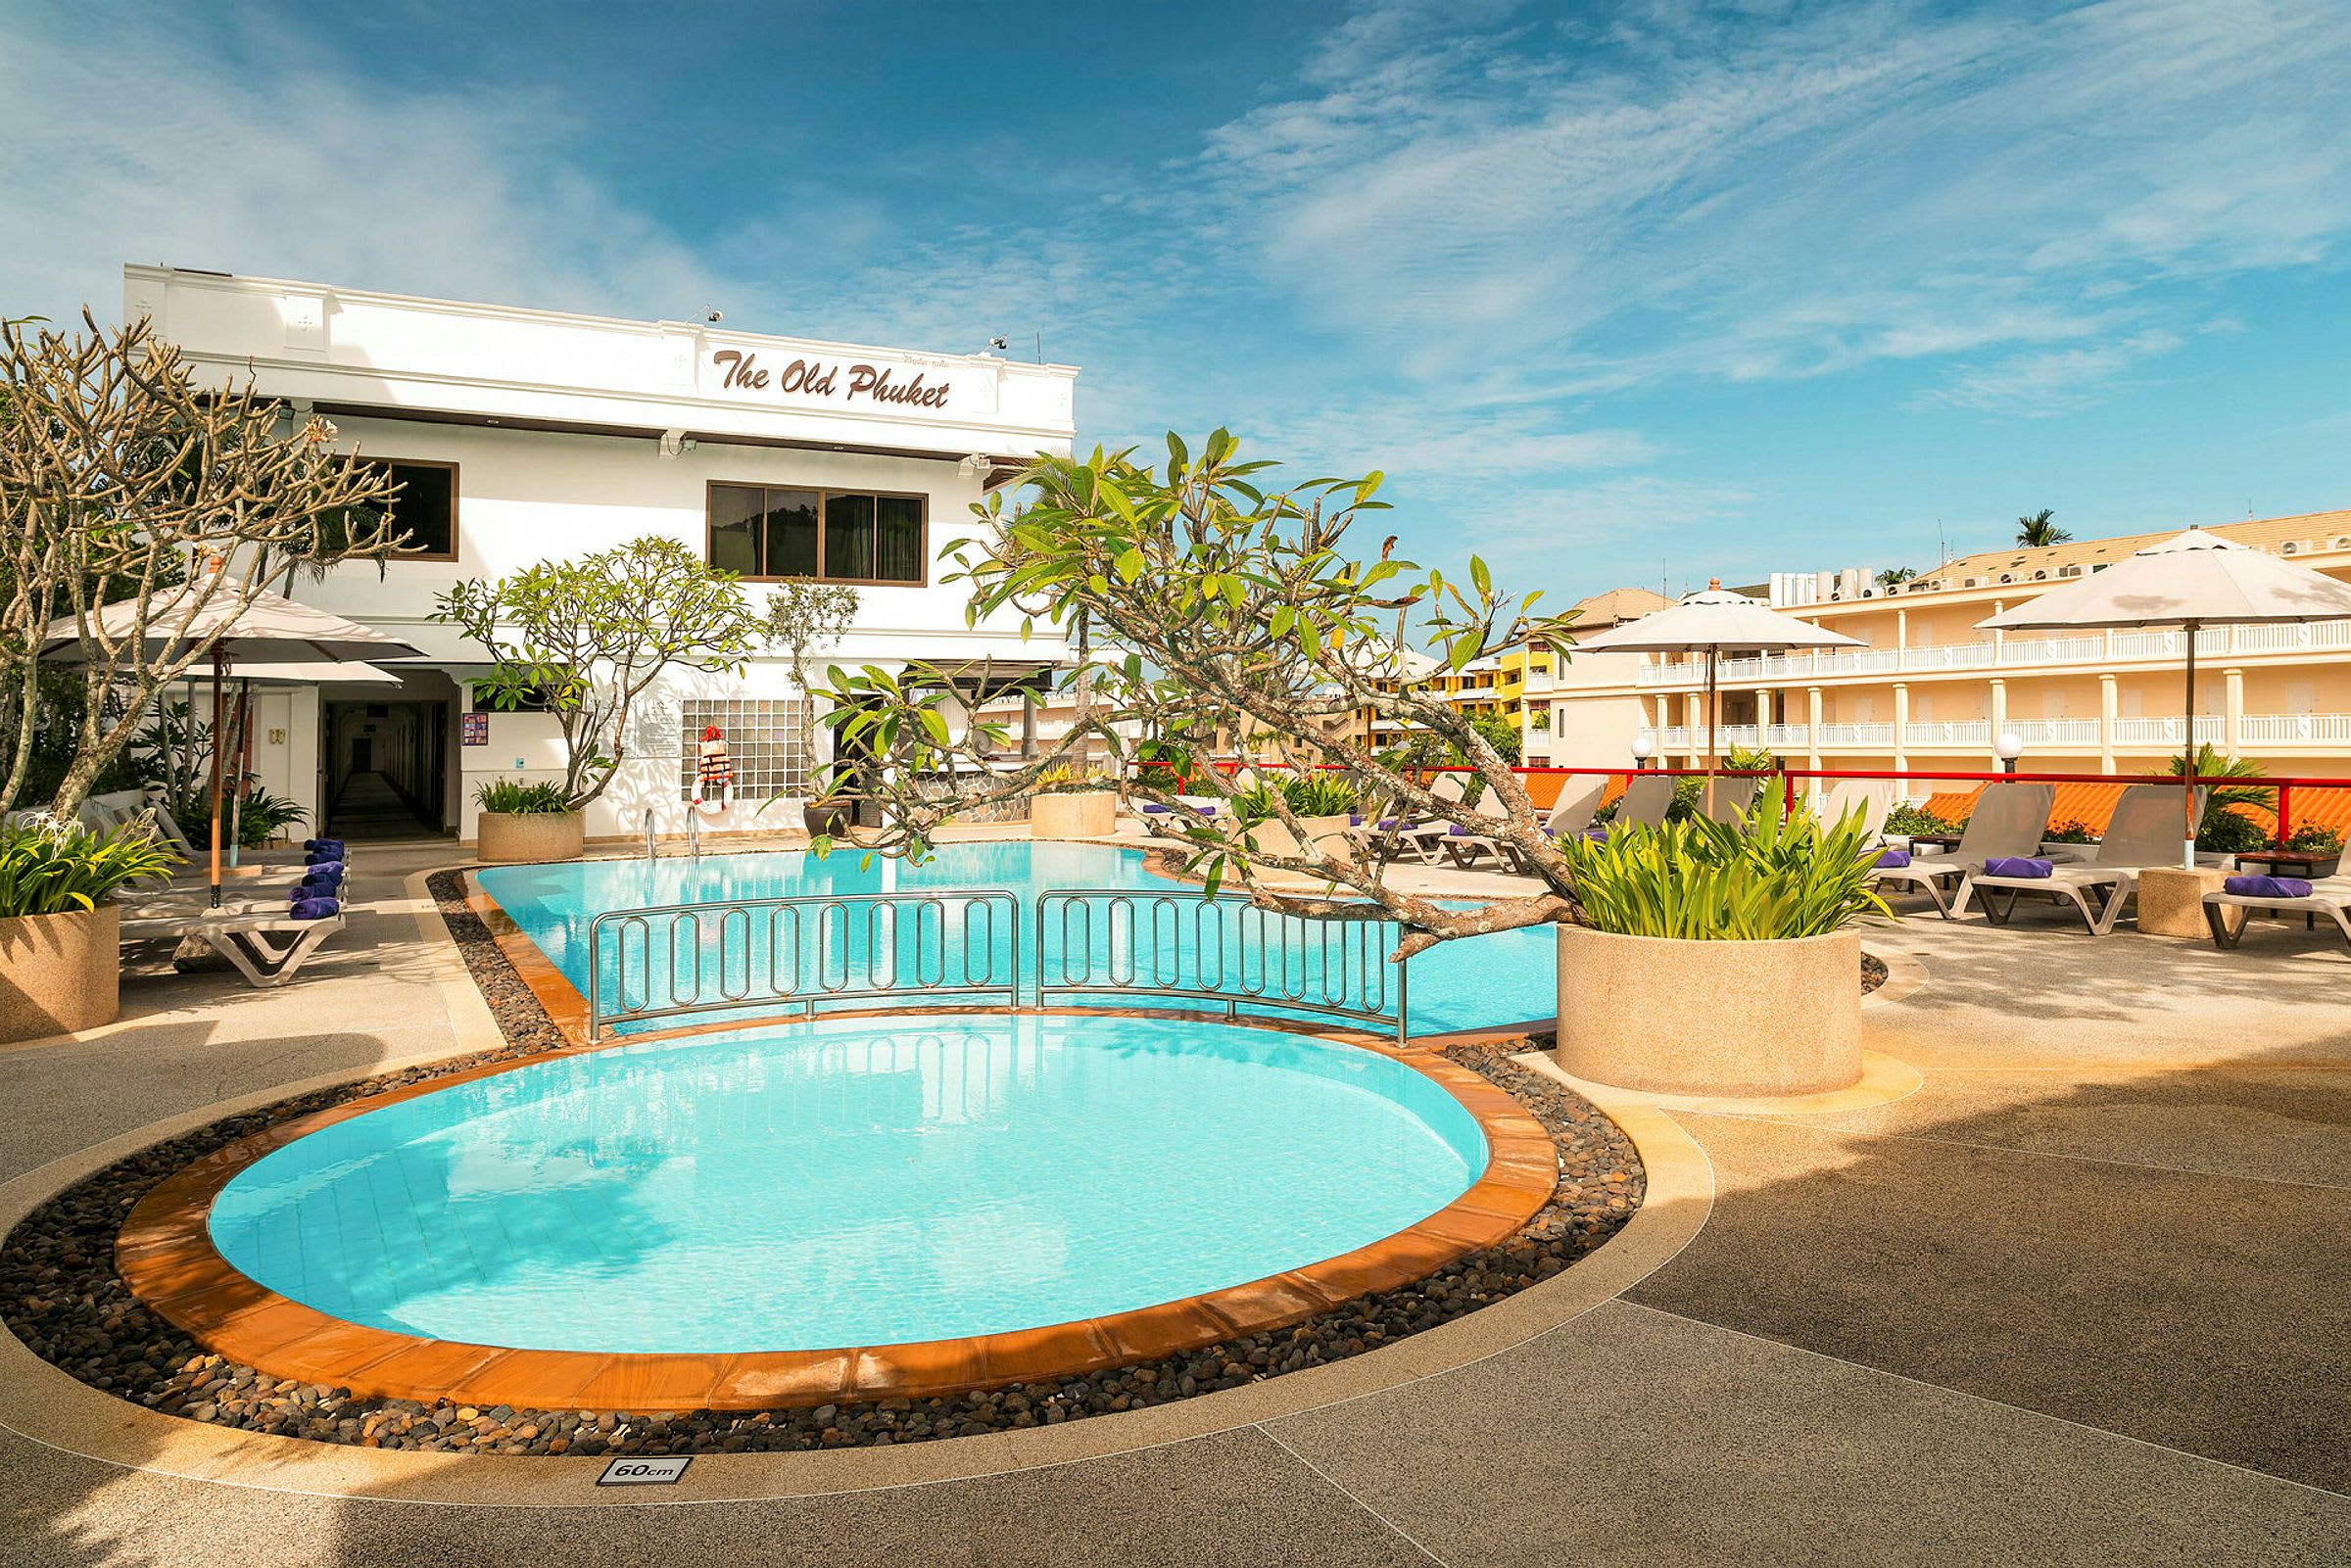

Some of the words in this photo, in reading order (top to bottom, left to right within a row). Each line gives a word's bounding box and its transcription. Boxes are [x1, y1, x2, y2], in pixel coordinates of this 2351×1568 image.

[714, 351, 769, 390] The
[782, 359, 838, 396] Old
[846, 364, 950, 408] Phuket
[614, 1464, 673, 1477] 60cm
